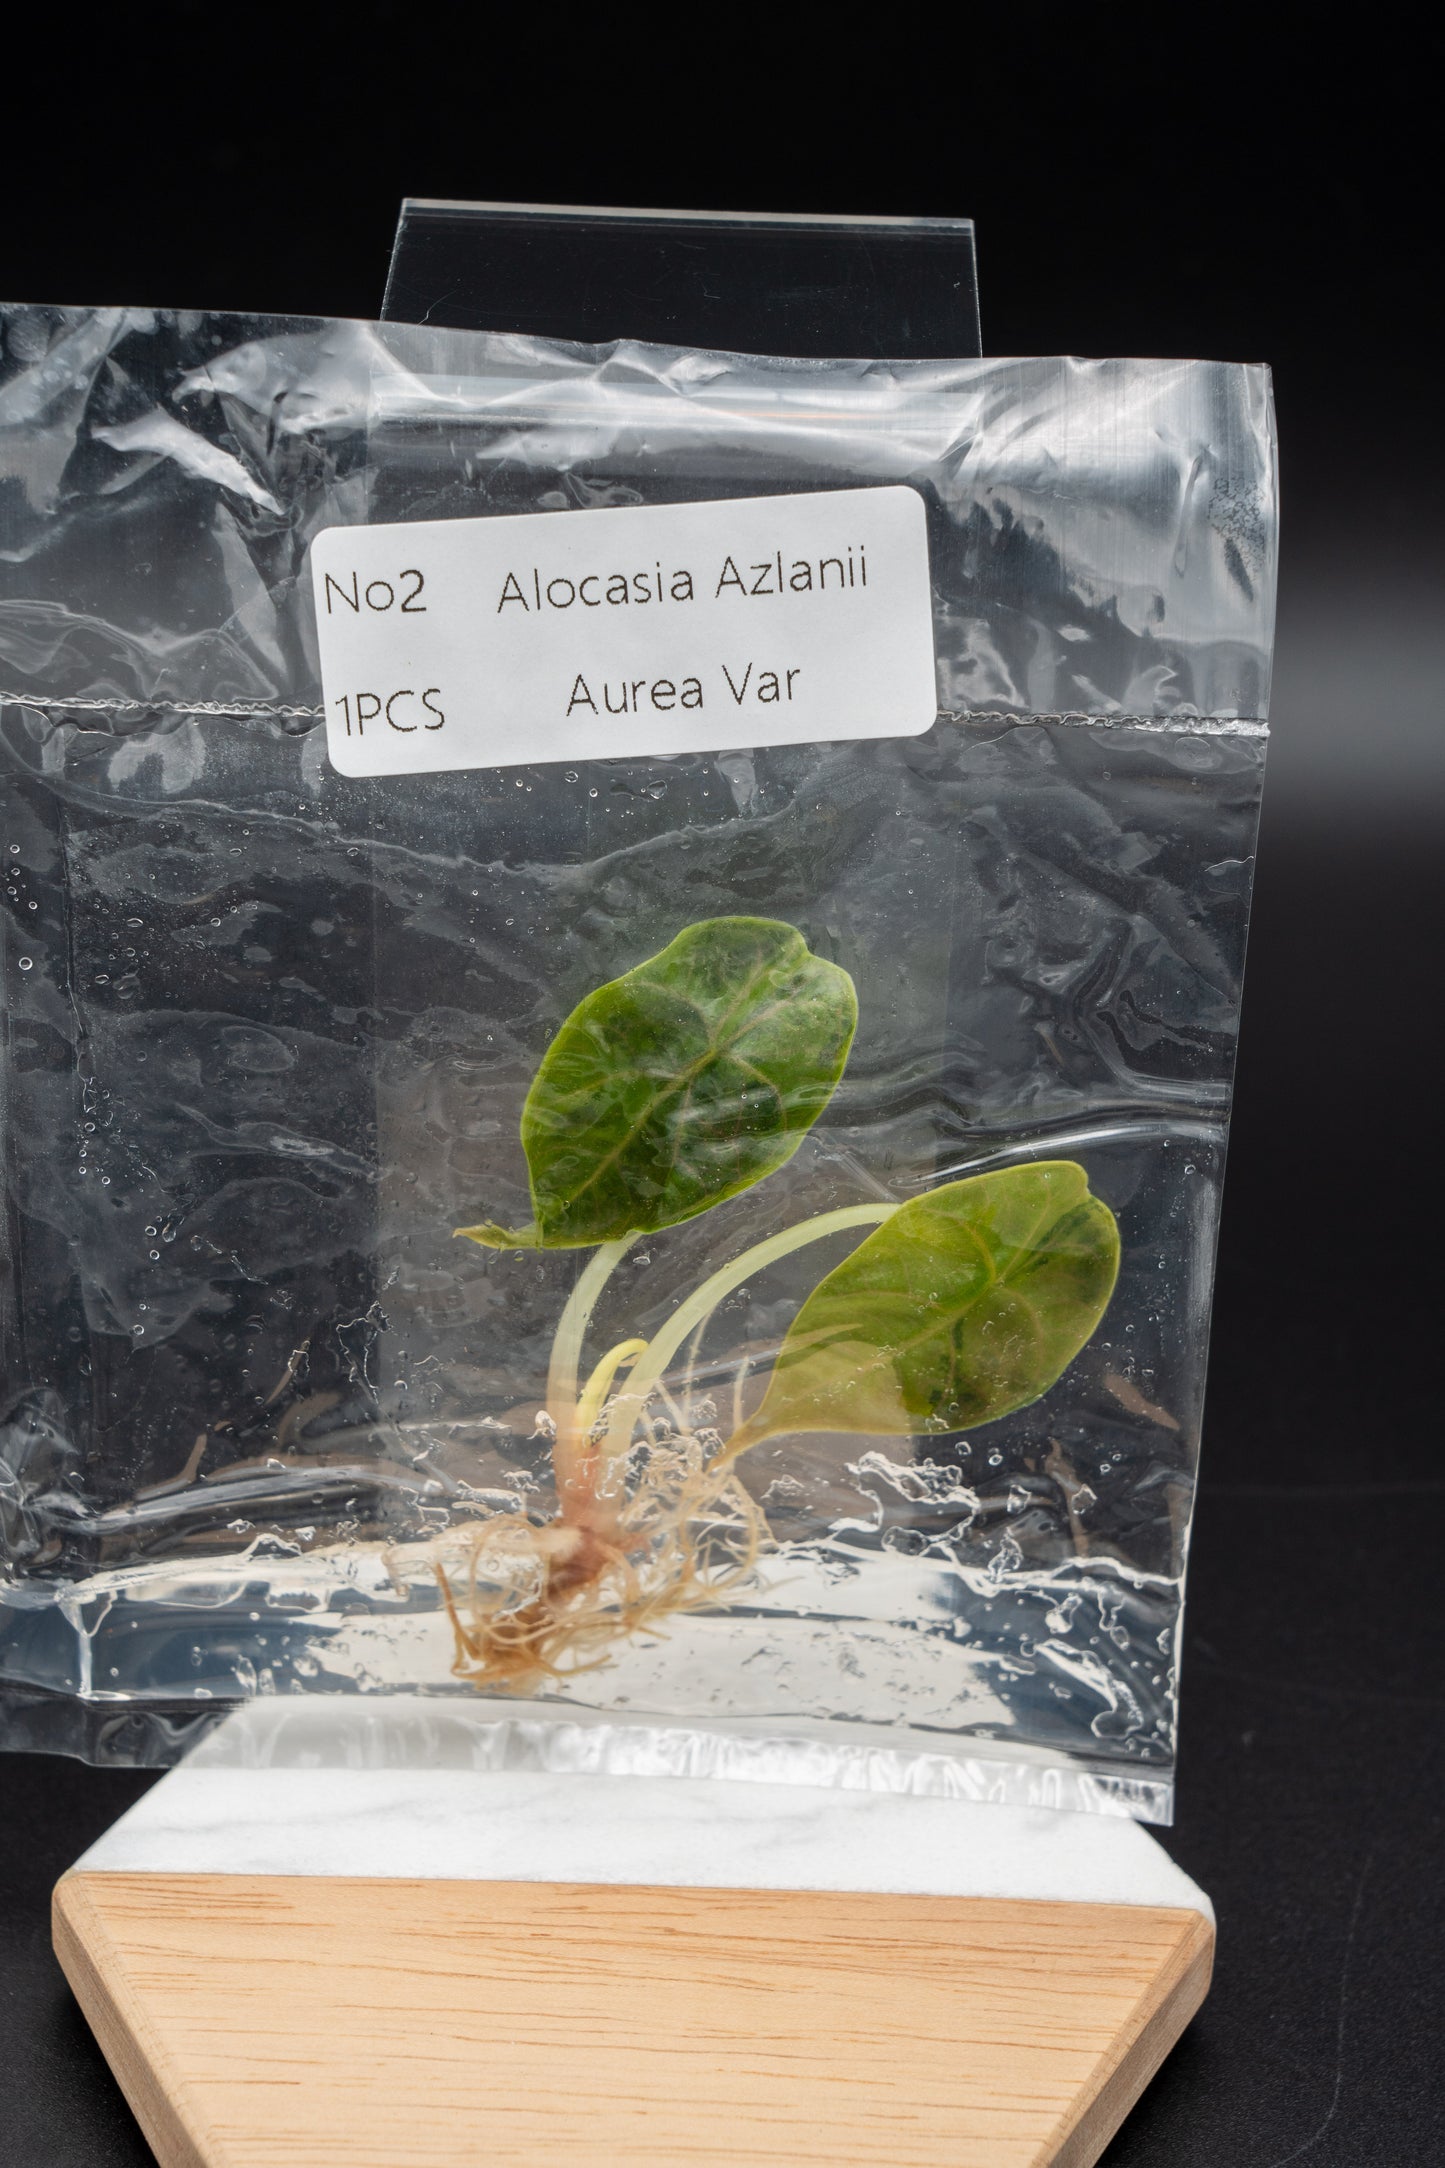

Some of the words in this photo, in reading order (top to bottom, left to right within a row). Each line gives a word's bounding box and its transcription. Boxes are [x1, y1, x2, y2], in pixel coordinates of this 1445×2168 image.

[324, 569, 427, 614] No2
[497, 561, 695, 613] Alocasia
[715, 544, 869, 600] Azlanii
[335, 687, 446, 737] 1PCS
[565, 673, 704, 718] Aurea
[721, 662, 802, 707] Var
